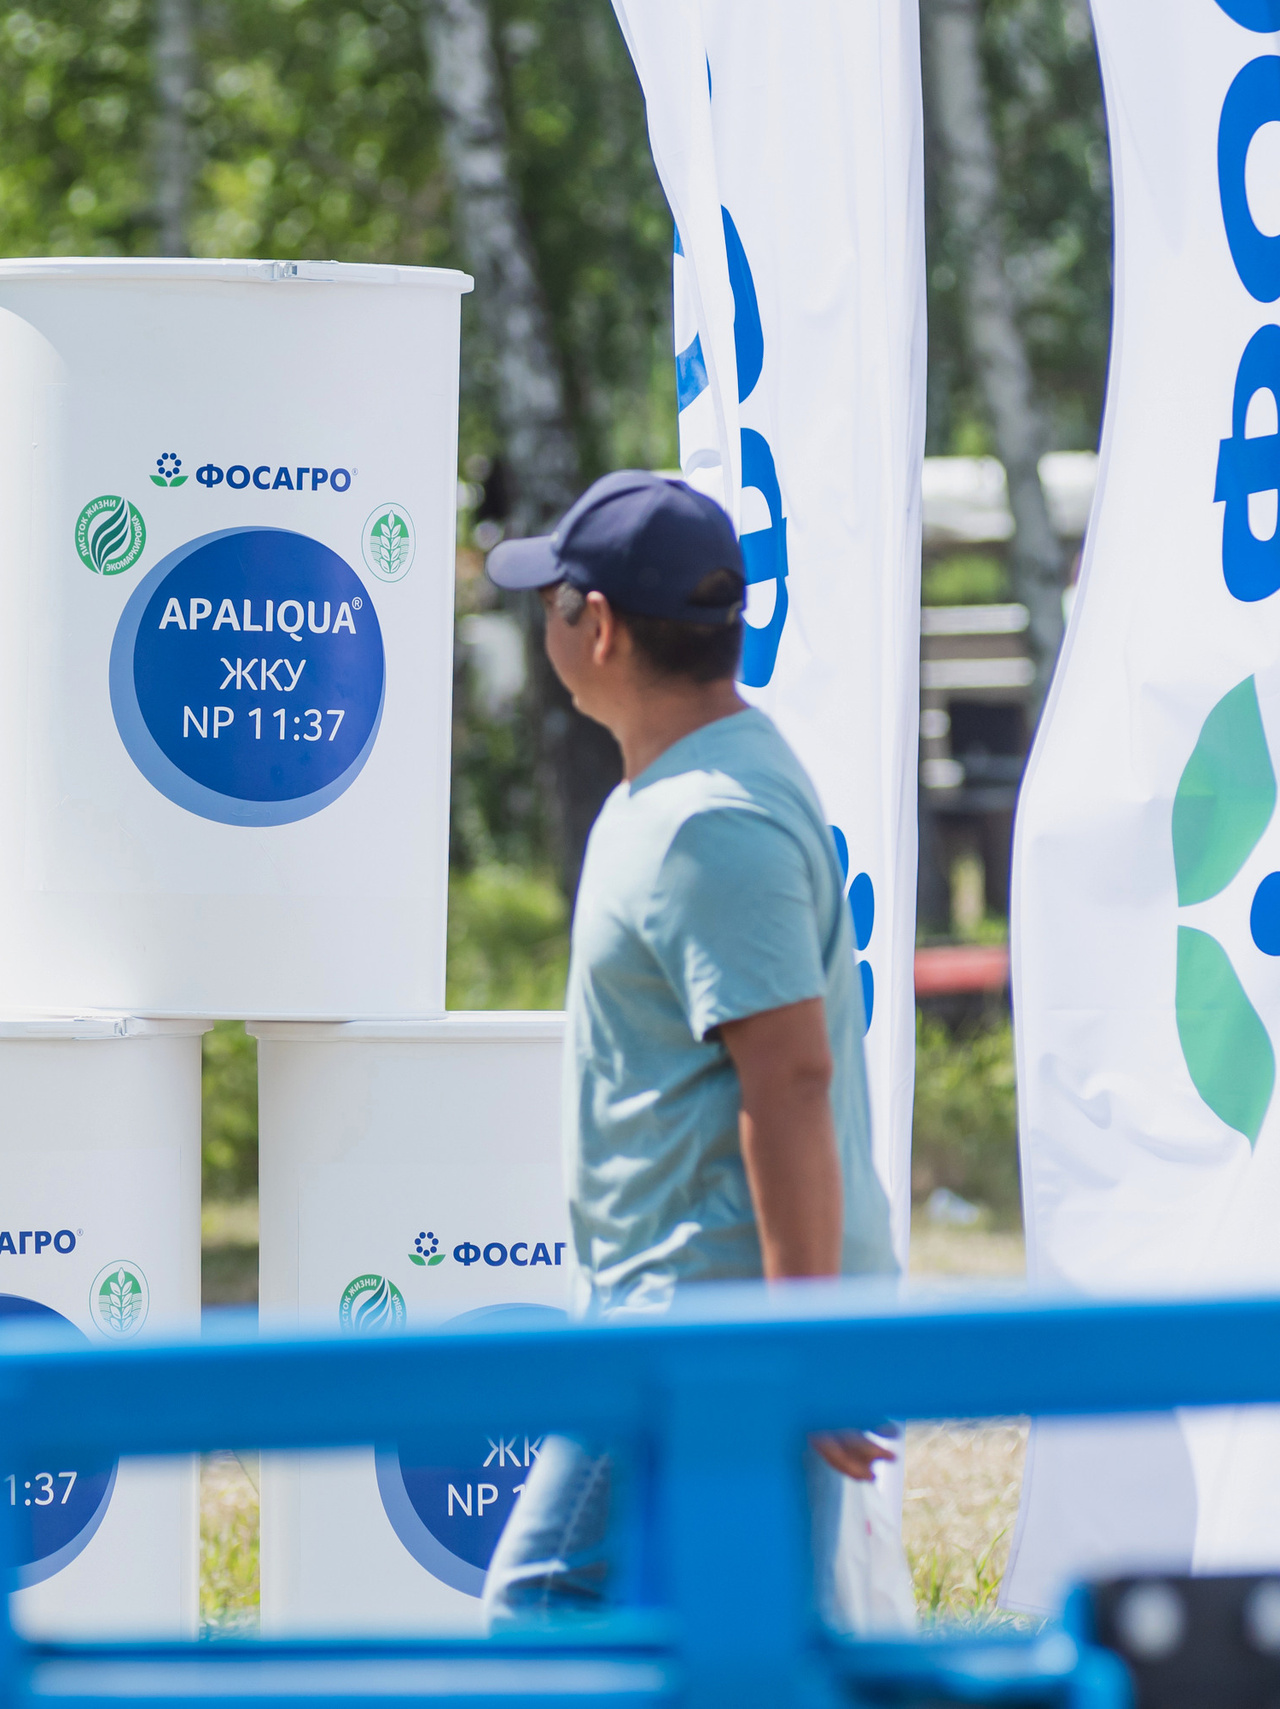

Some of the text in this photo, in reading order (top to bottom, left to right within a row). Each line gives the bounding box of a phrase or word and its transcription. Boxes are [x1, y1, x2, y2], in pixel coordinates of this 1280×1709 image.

[77, 499, 117, 557] ЛИСТОК ЖИЗНИ
[105, 514, 143, 572] ЭКОМАРКИРОВКА
[219, 657, 307, 692] ЖКУ
[183, 705, 345, 742] NP 11:37
[453, 1241, 567, 1266] ФОСАГ
[347, 1278, 378, 1297] ЖИЗНИ
[482, 1434, 541, 1467] ЖК
[3, 1472, 78, 1507] 1:37
[447, 1483, 499, 1517] NP
